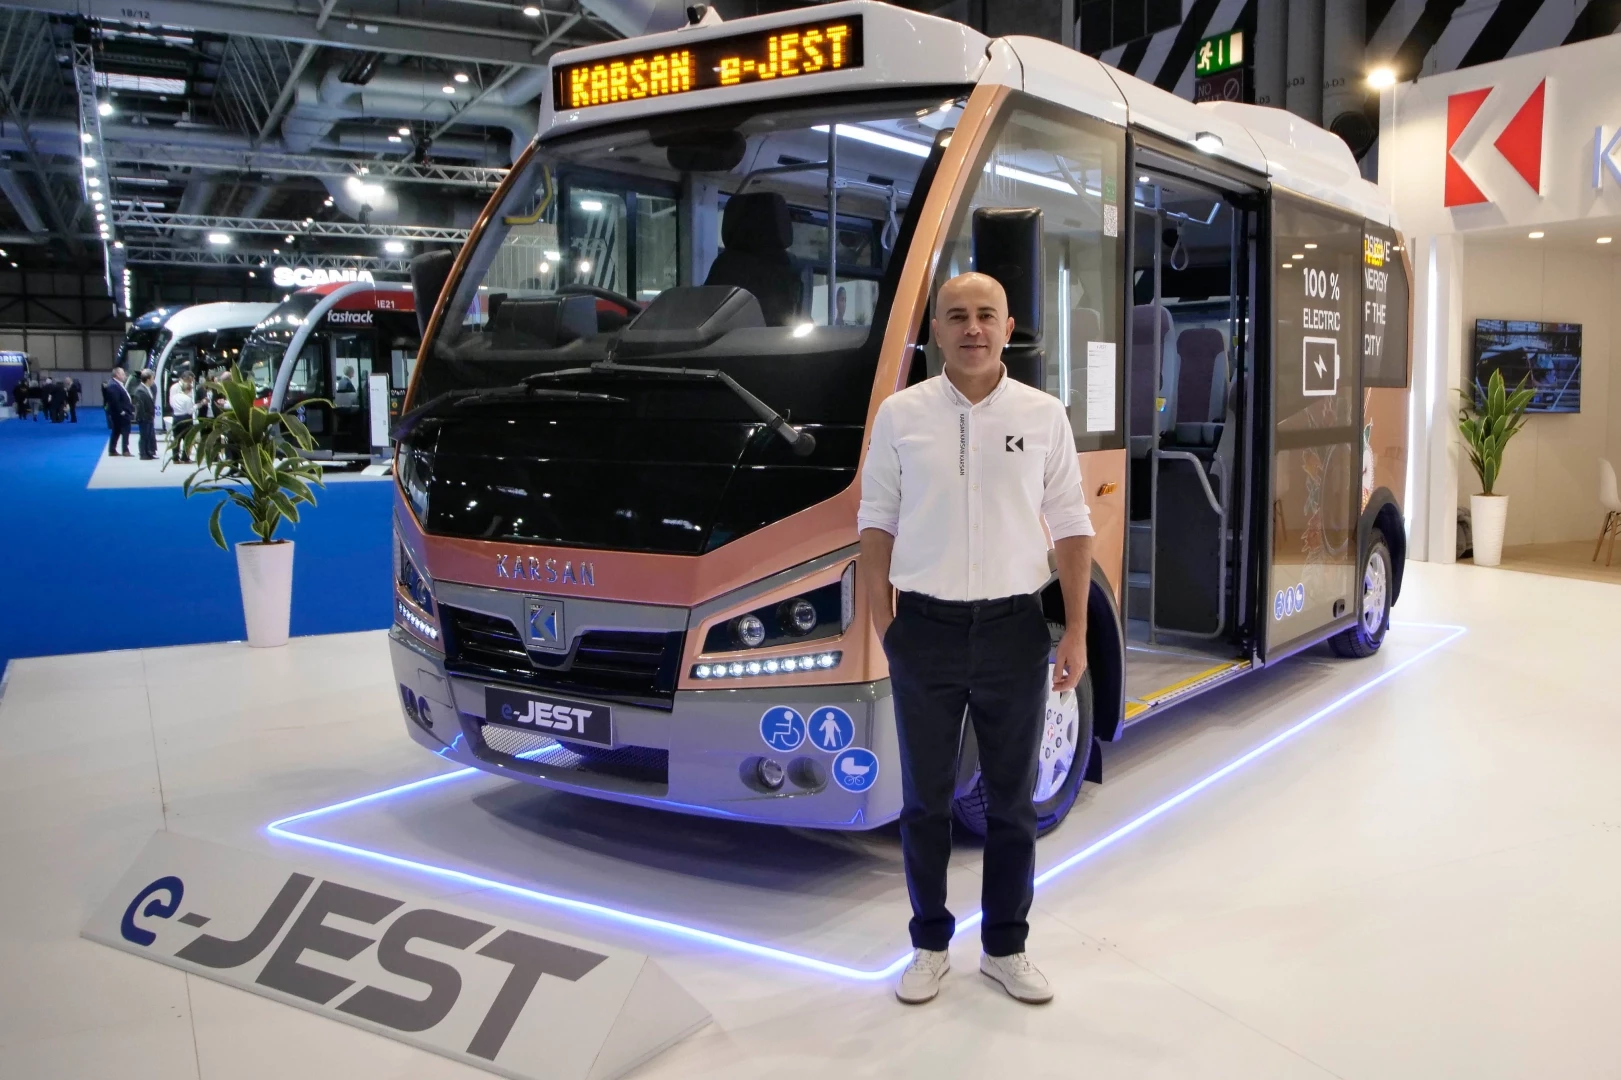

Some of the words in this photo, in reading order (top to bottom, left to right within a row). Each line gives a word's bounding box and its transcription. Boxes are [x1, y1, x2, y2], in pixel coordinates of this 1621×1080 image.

[572, 51, 690, 107] KARSAN
[721, 25, 848, 84] e-JEST
[1198, 83, 1212, 98] NO
[273, 267, 375, 287] SCANIA
[1303, 267, 1326, 298] 100
[1330, 272, 1340, 301] %
[327, 309, 374, 323] fastrack
[1303, 308, 1340, 331] ELECTRIC
[1372, 302, 1386, 325] THE
[1364, 333, 1381, 356] CITY
[496, 553, 595, 586] KARSAN
[501, 700, 593, 733] e-JEST
[120, 872, 610, 1062] e-JEST
